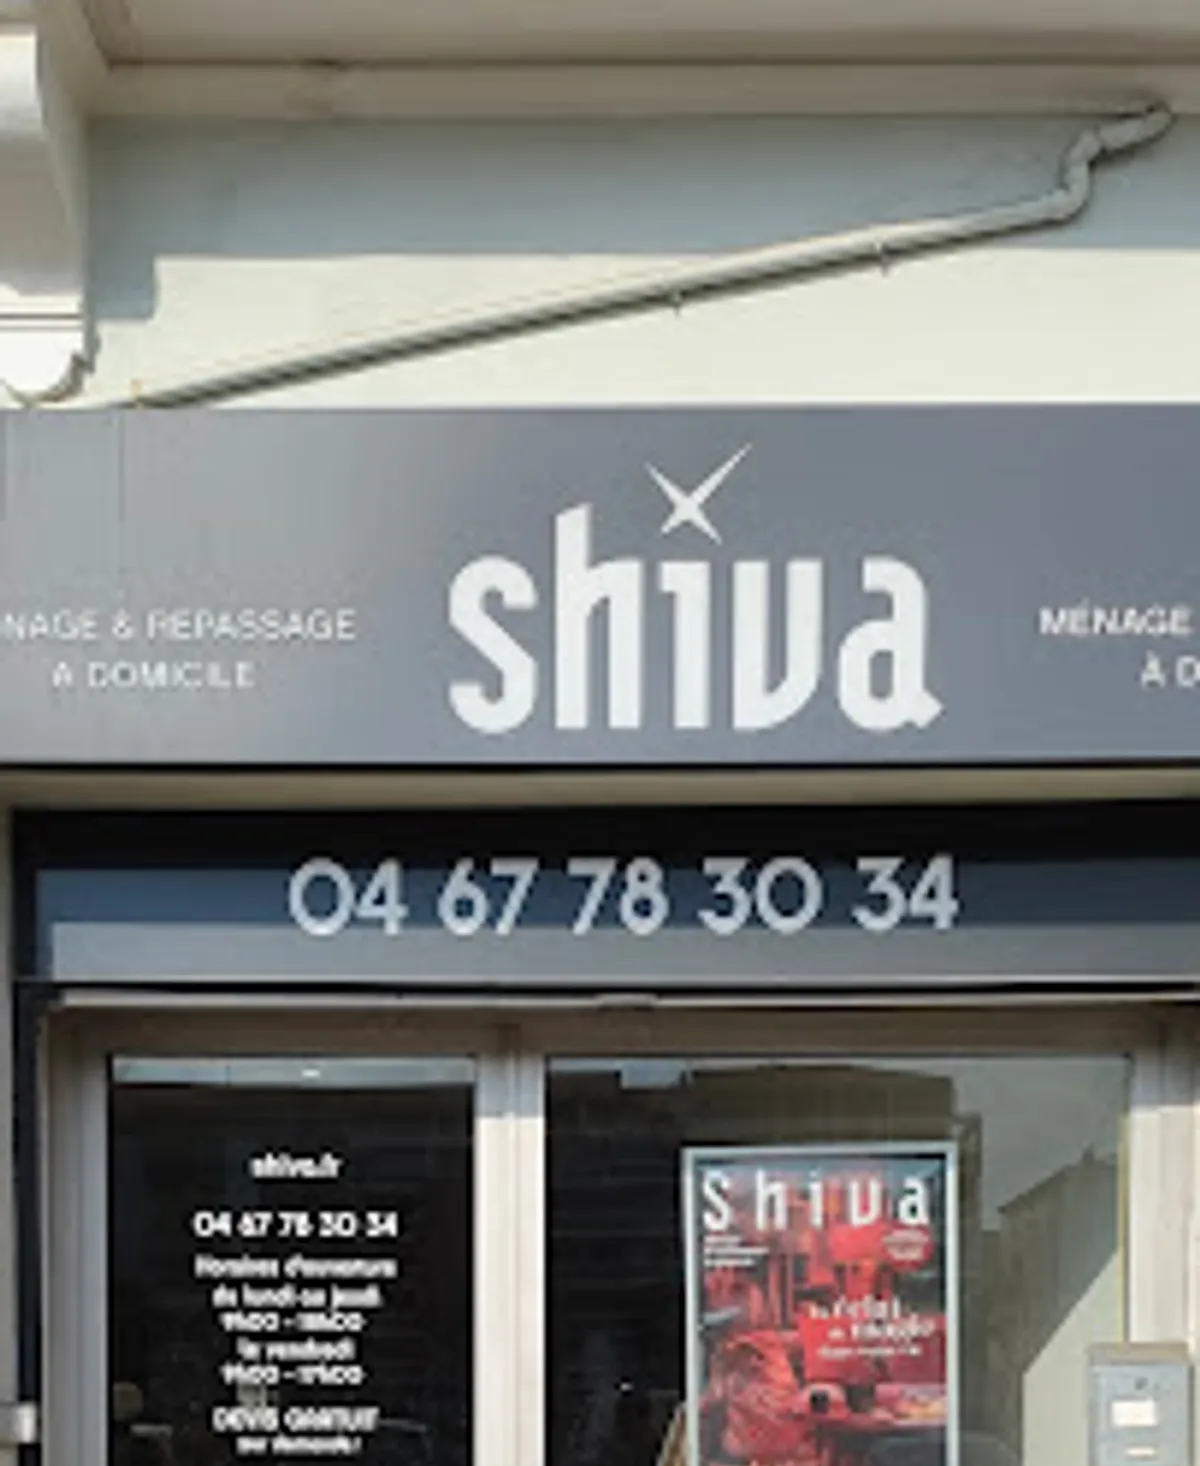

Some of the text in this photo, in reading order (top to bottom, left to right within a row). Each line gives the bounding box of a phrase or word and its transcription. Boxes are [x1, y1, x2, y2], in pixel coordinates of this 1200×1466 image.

[448, 443, 943, 733] shiva
[111, 608, 135, 641] &
[147, 607, 357, 641] REPASSAGE
[1039, 598, 1192, 637] MÉNAGE
[88, 660, 256, 688] DOMICILE
[288, 853, 959, 937] 04 67 78 30 34
[193, 1210, 398, 1238] 04 67 78 30 34
[212, 1406, 380, 1433] DEVIS GRATUIT
